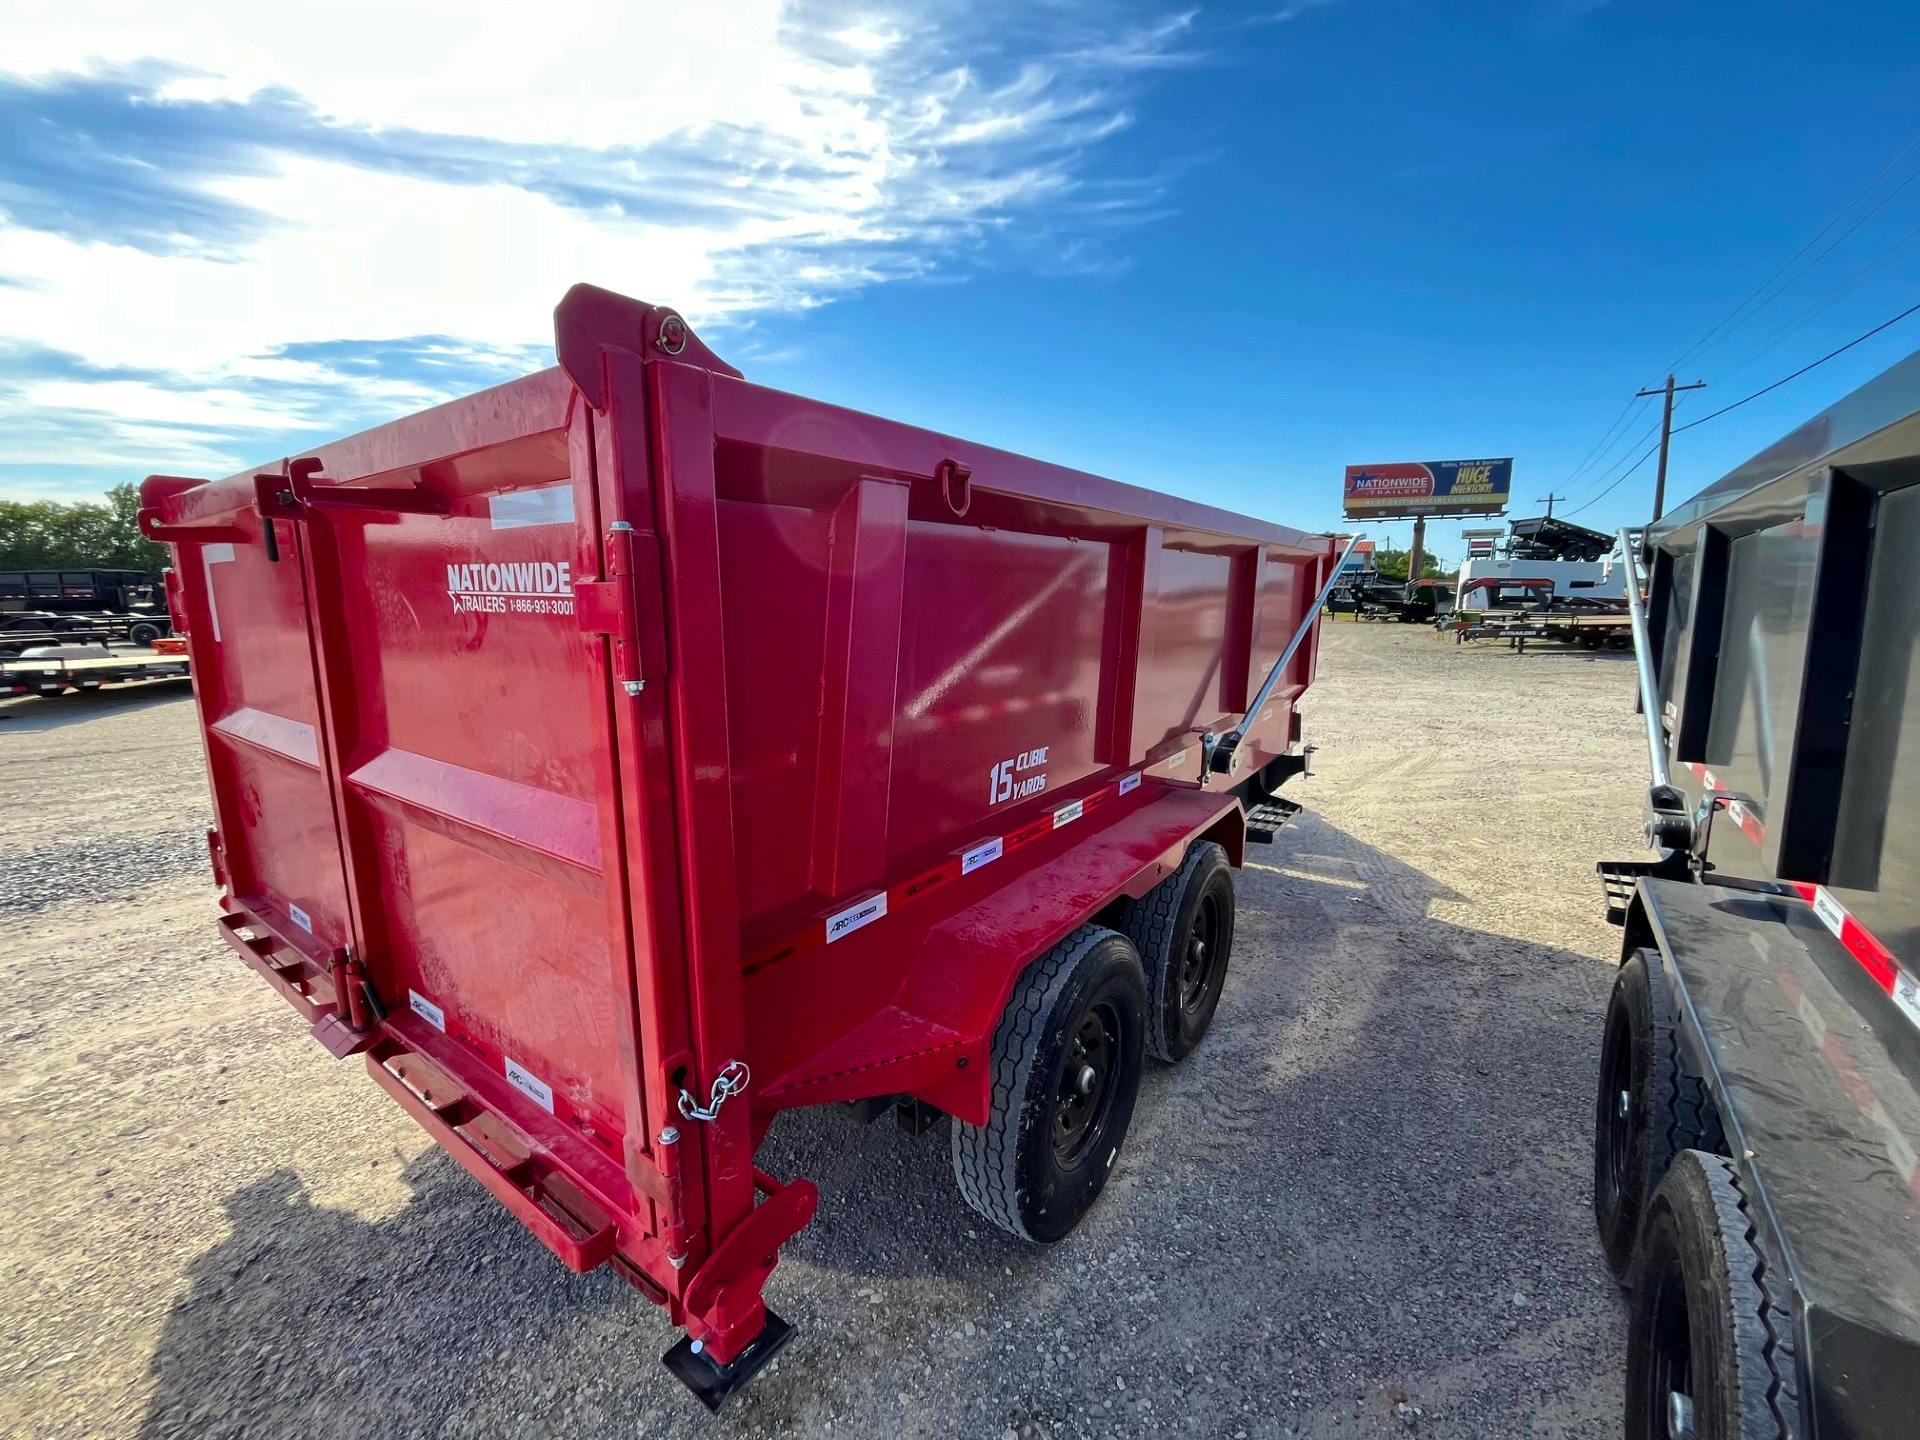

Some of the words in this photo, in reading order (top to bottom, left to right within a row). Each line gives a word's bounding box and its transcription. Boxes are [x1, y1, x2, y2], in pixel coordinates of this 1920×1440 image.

[1356, 477, 1429, 489] NATIONWIDE
[1455, 466, 1493, 484] HUGE
[1370, 488, 1428, 496] TRAILERS
[1450, 482, 1494, 495] INVENTORY!
[447, 561, 572, 593] NATIONWIDE
[460, 595, 507, 614] TRAILERS
[509, 598, 574, 615] 1-866-931-3001
[989, 758, 1014, 806] 15
[1016, 746, 1050, 772] CUBIC
[1013, 773, 1047, 800] YARDS
[829, 917, 850, 935] ARC
